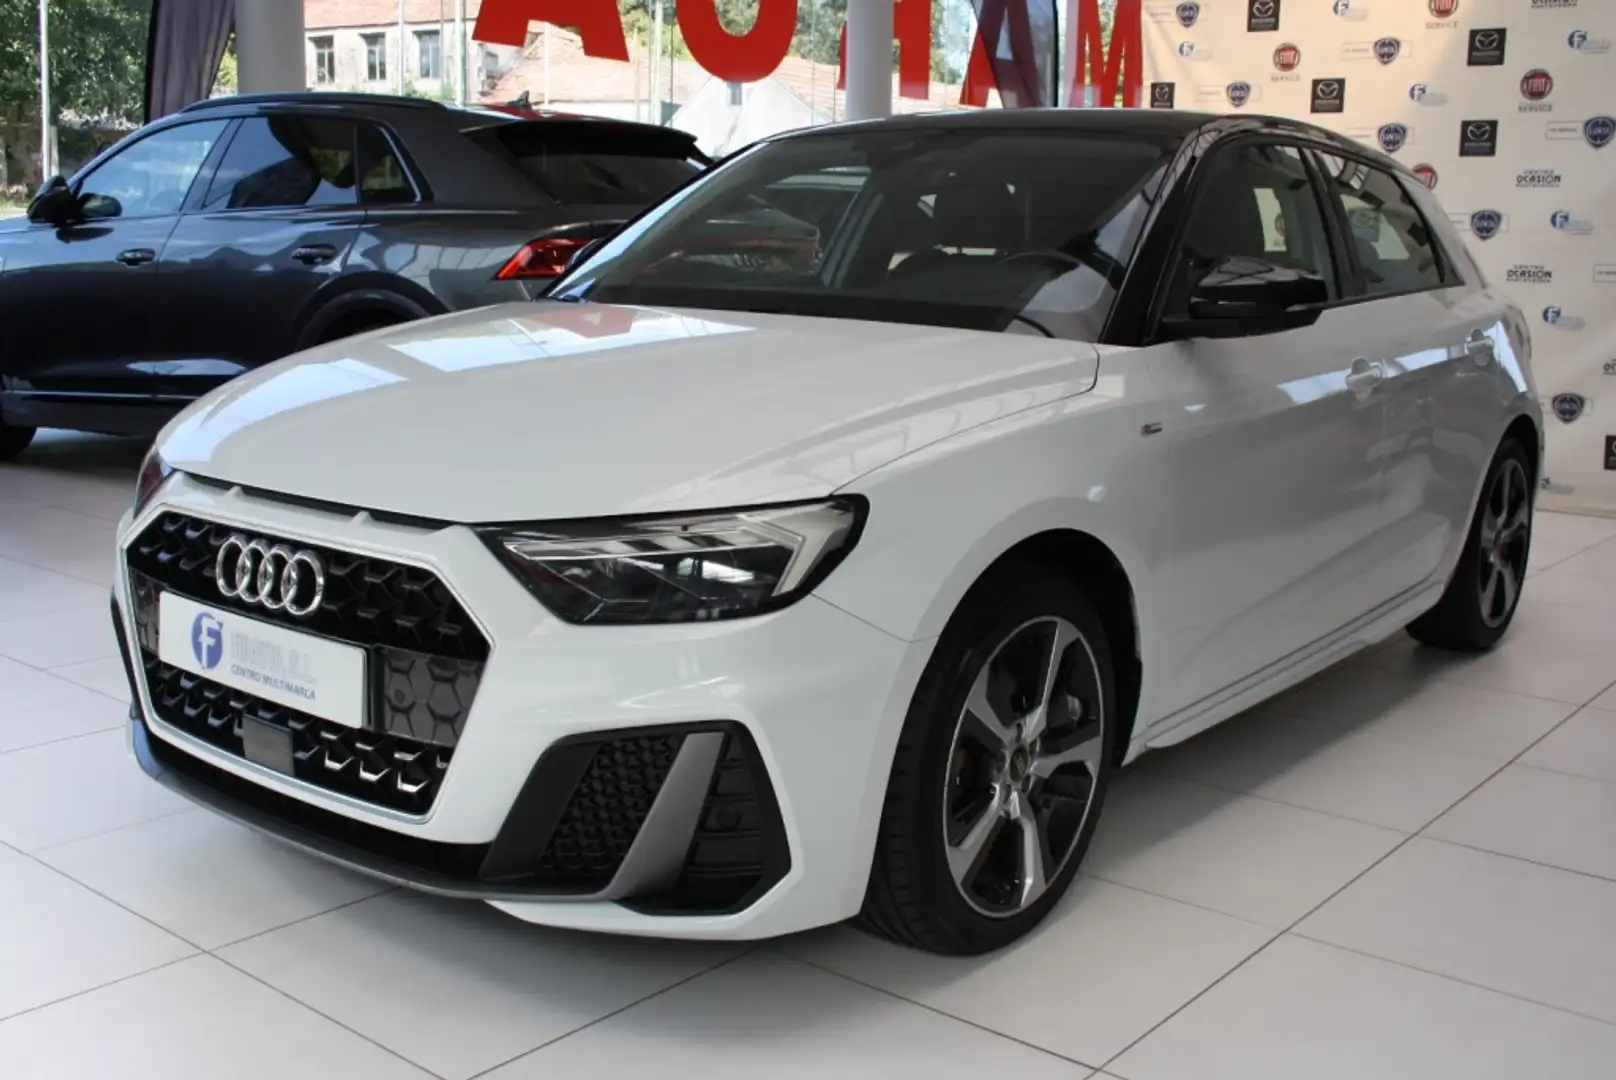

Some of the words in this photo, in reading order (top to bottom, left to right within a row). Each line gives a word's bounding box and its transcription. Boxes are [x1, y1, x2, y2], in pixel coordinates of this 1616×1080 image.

[1518, 104, 1553, 113] SERVICE
[231, 664, 261, 681] CENTRO
[262, 675, 316, 700] MULTIMARCA
